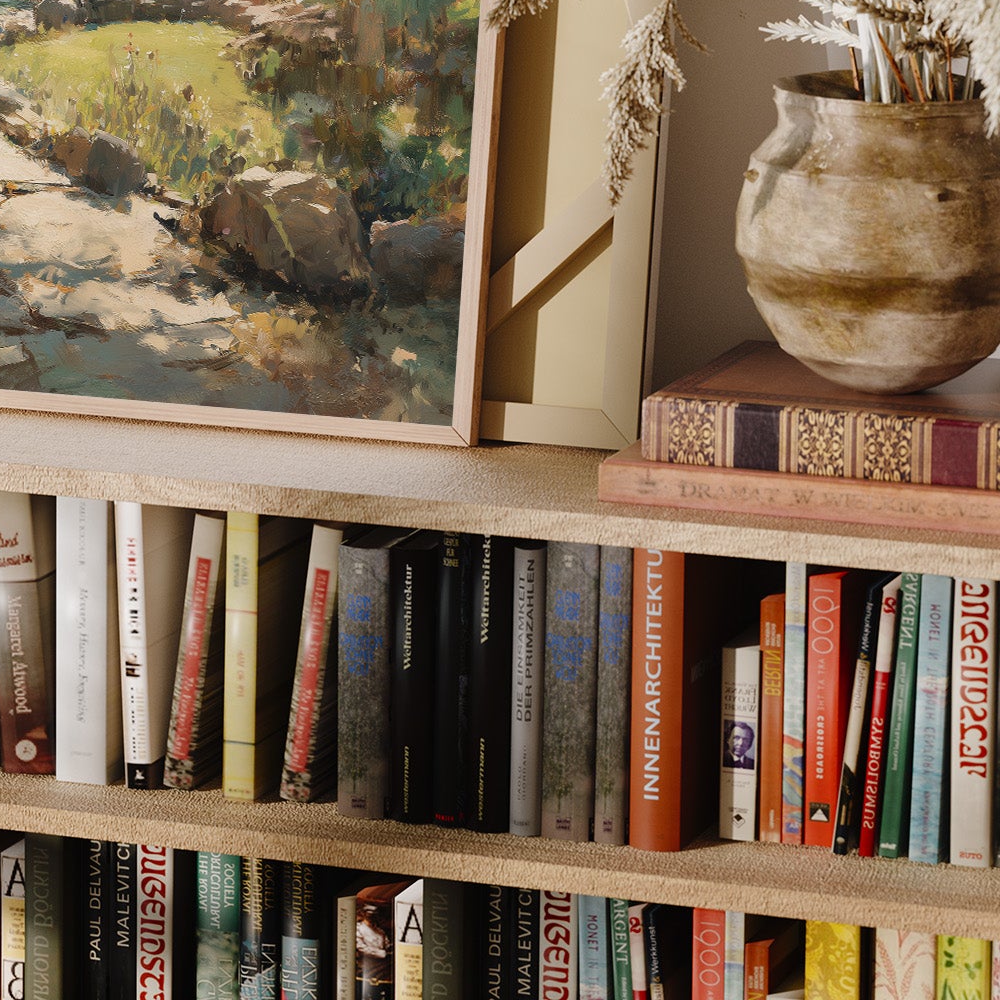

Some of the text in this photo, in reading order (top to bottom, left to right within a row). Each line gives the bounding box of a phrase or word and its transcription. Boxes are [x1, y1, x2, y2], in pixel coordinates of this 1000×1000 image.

[6, 596, 32, 714] Margaret Atwood
[403, 564, 413, 671] Weltarchitektur
[516, 574, 526, 686] EINSAMKEIT
[524, 559, 536, 722] DER PRIMZAHLEN
[643, 548, 664, 801] INNENARCHITEKTU
[88, 840, 101, 961] PAUL DELVAU
[488, 886, 502, 956] DELVAU
[587, 914, 598, 952] MONET
[613, 898, 629, 965] ARGENT
[650, 925, 660, 974] Werkkunst
[699, 921, 722, 987] 1900
